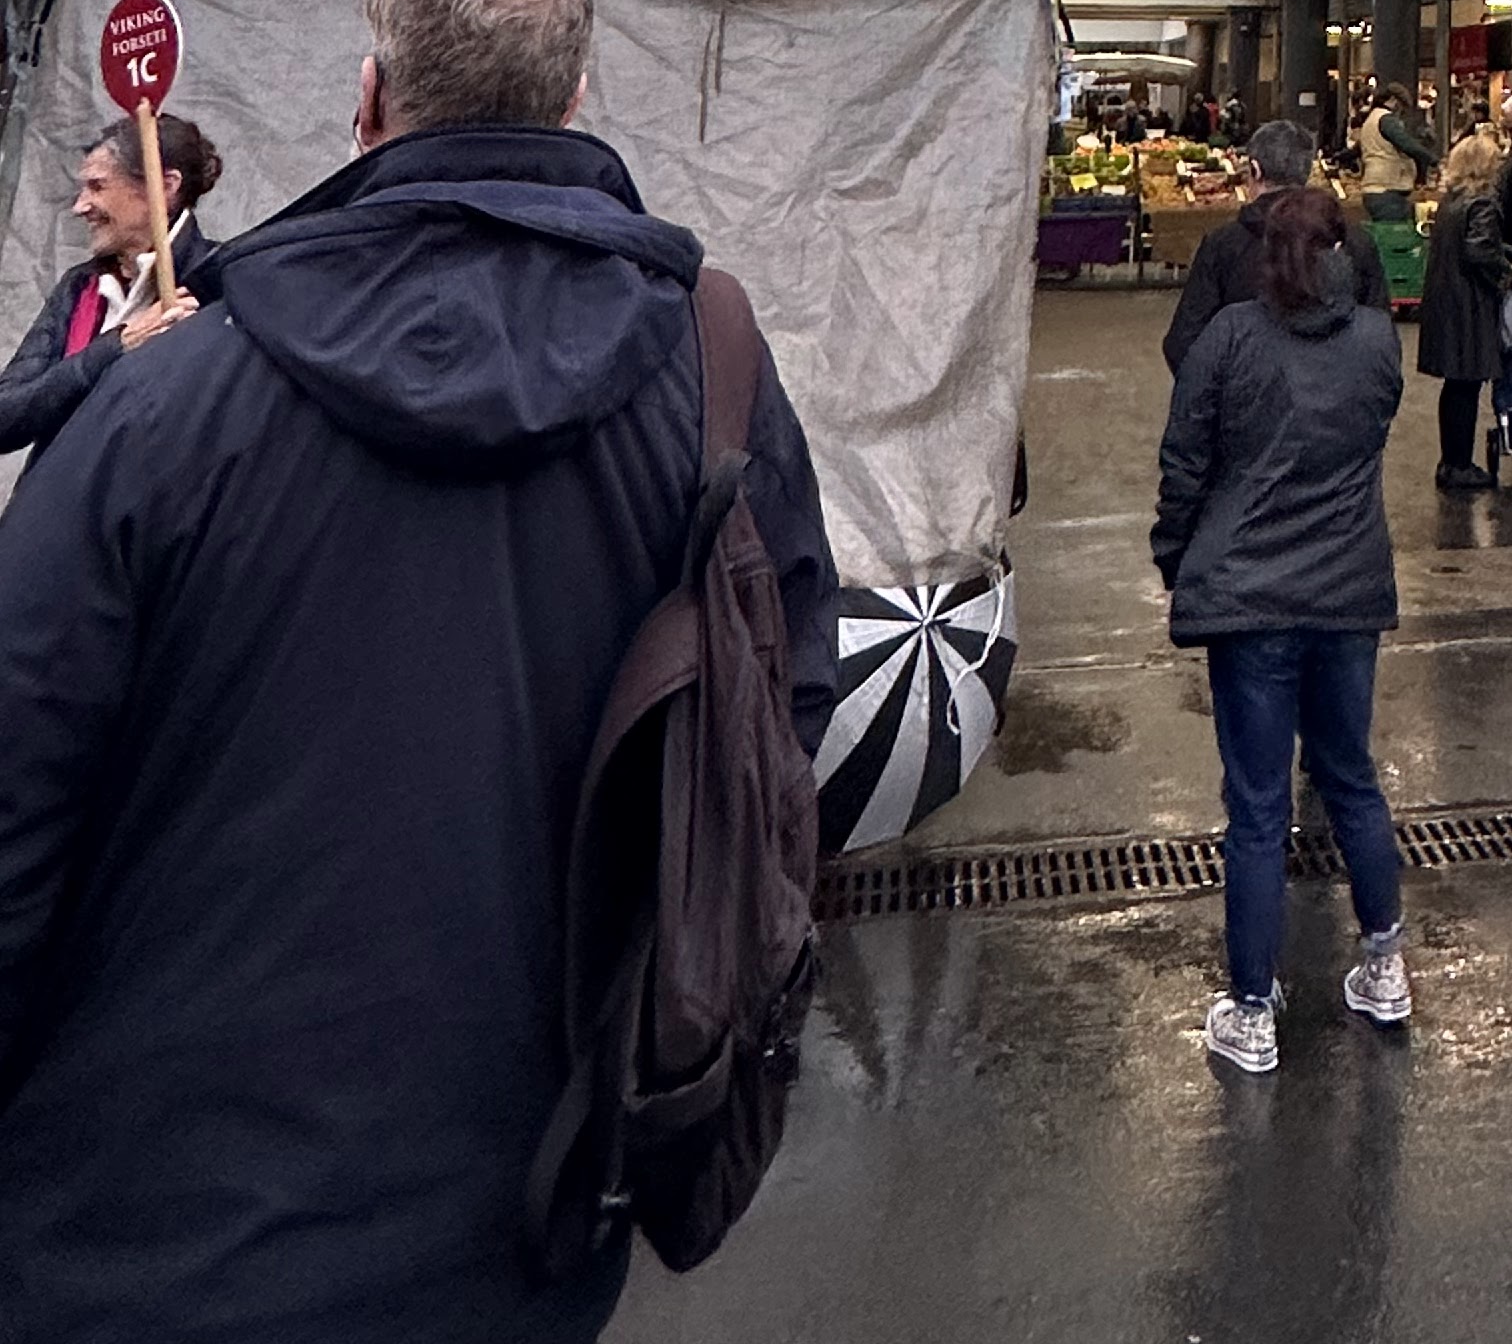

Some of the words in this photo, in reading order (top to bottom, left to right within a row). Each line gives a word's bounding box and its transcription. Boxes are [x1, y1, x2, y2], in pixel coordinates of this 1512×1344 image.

[110, 7, 165, 35] VIKING
[112, 29, 167, 56] FORSETI
[126, 51, 159, 88] 1C
